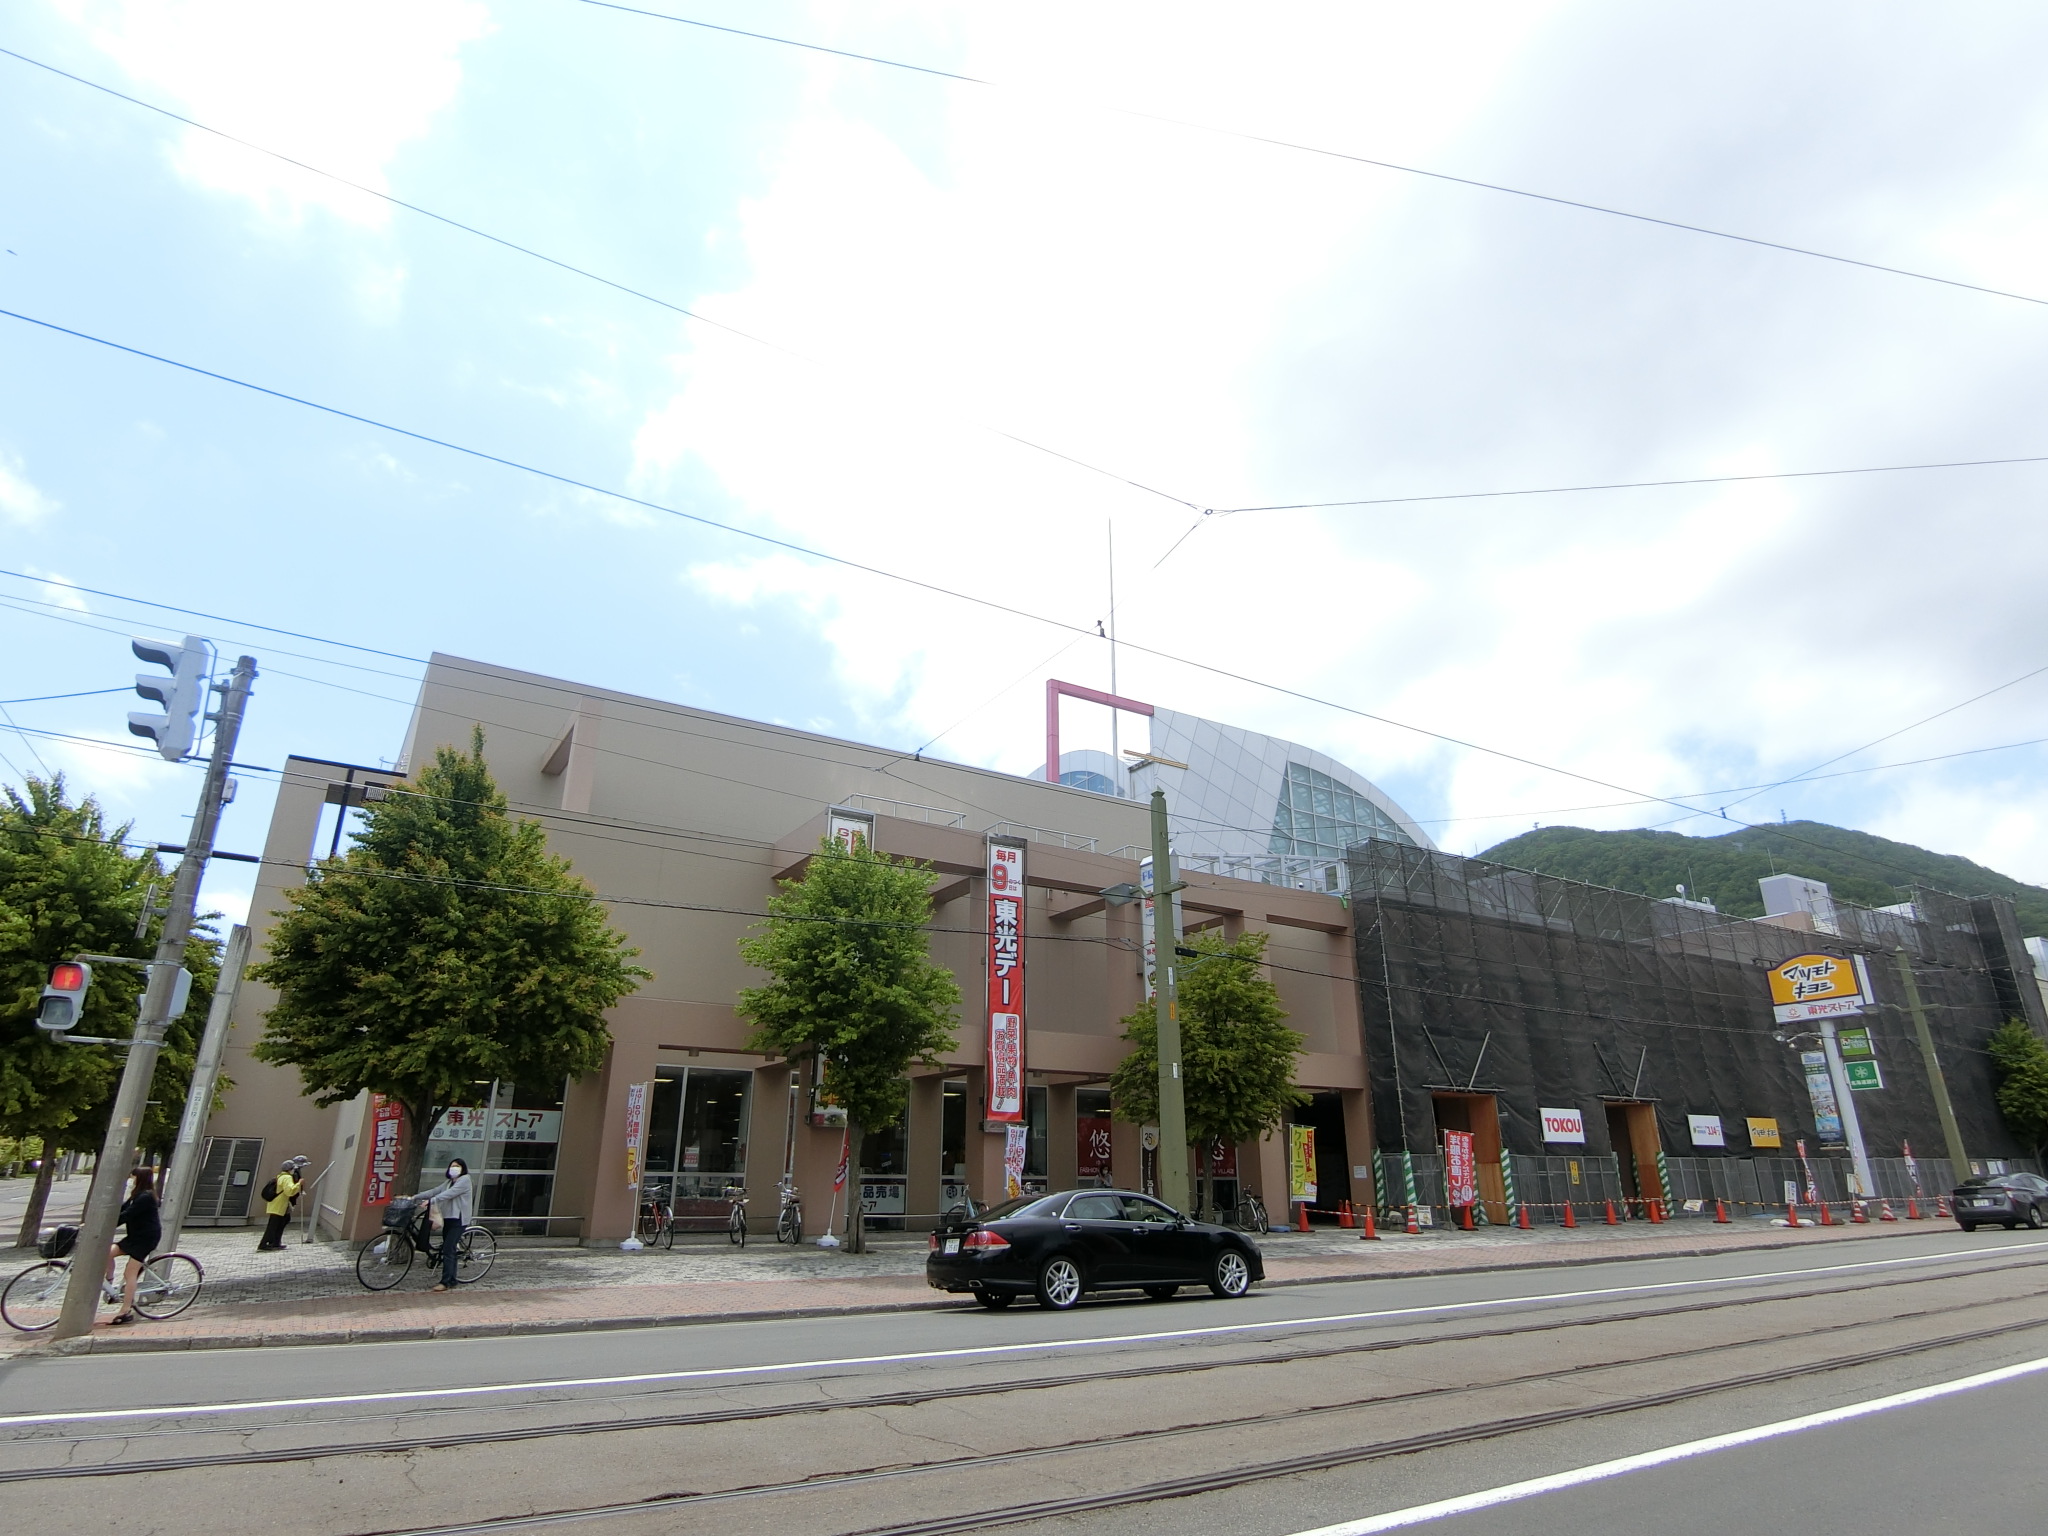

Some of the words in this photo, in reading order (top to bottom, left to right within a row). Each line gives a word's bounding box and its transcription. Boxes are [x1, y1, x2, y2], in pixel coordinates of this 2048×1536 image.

[996, 849, 1016, 863] 毎月
[992, 863, 1008, 891] 9
[994, 899, 1018, 1005] 東光デー
[1782, 961, 1835, 981] マツモト
[1794, 981, 1833, 999] キヨシ
[1807, 1000, 1855, 1016] 東光ストア
[446, 1109, 543, 1128] 東光ストア
[1545, 1118, 1581, 1133] TOKOU
[449, 1128, 537, 1140] 地下食料品売場
[1089, 1128, 1112, 1159] 悠
[1293, 1130, 1304, 1193] クリーニング
